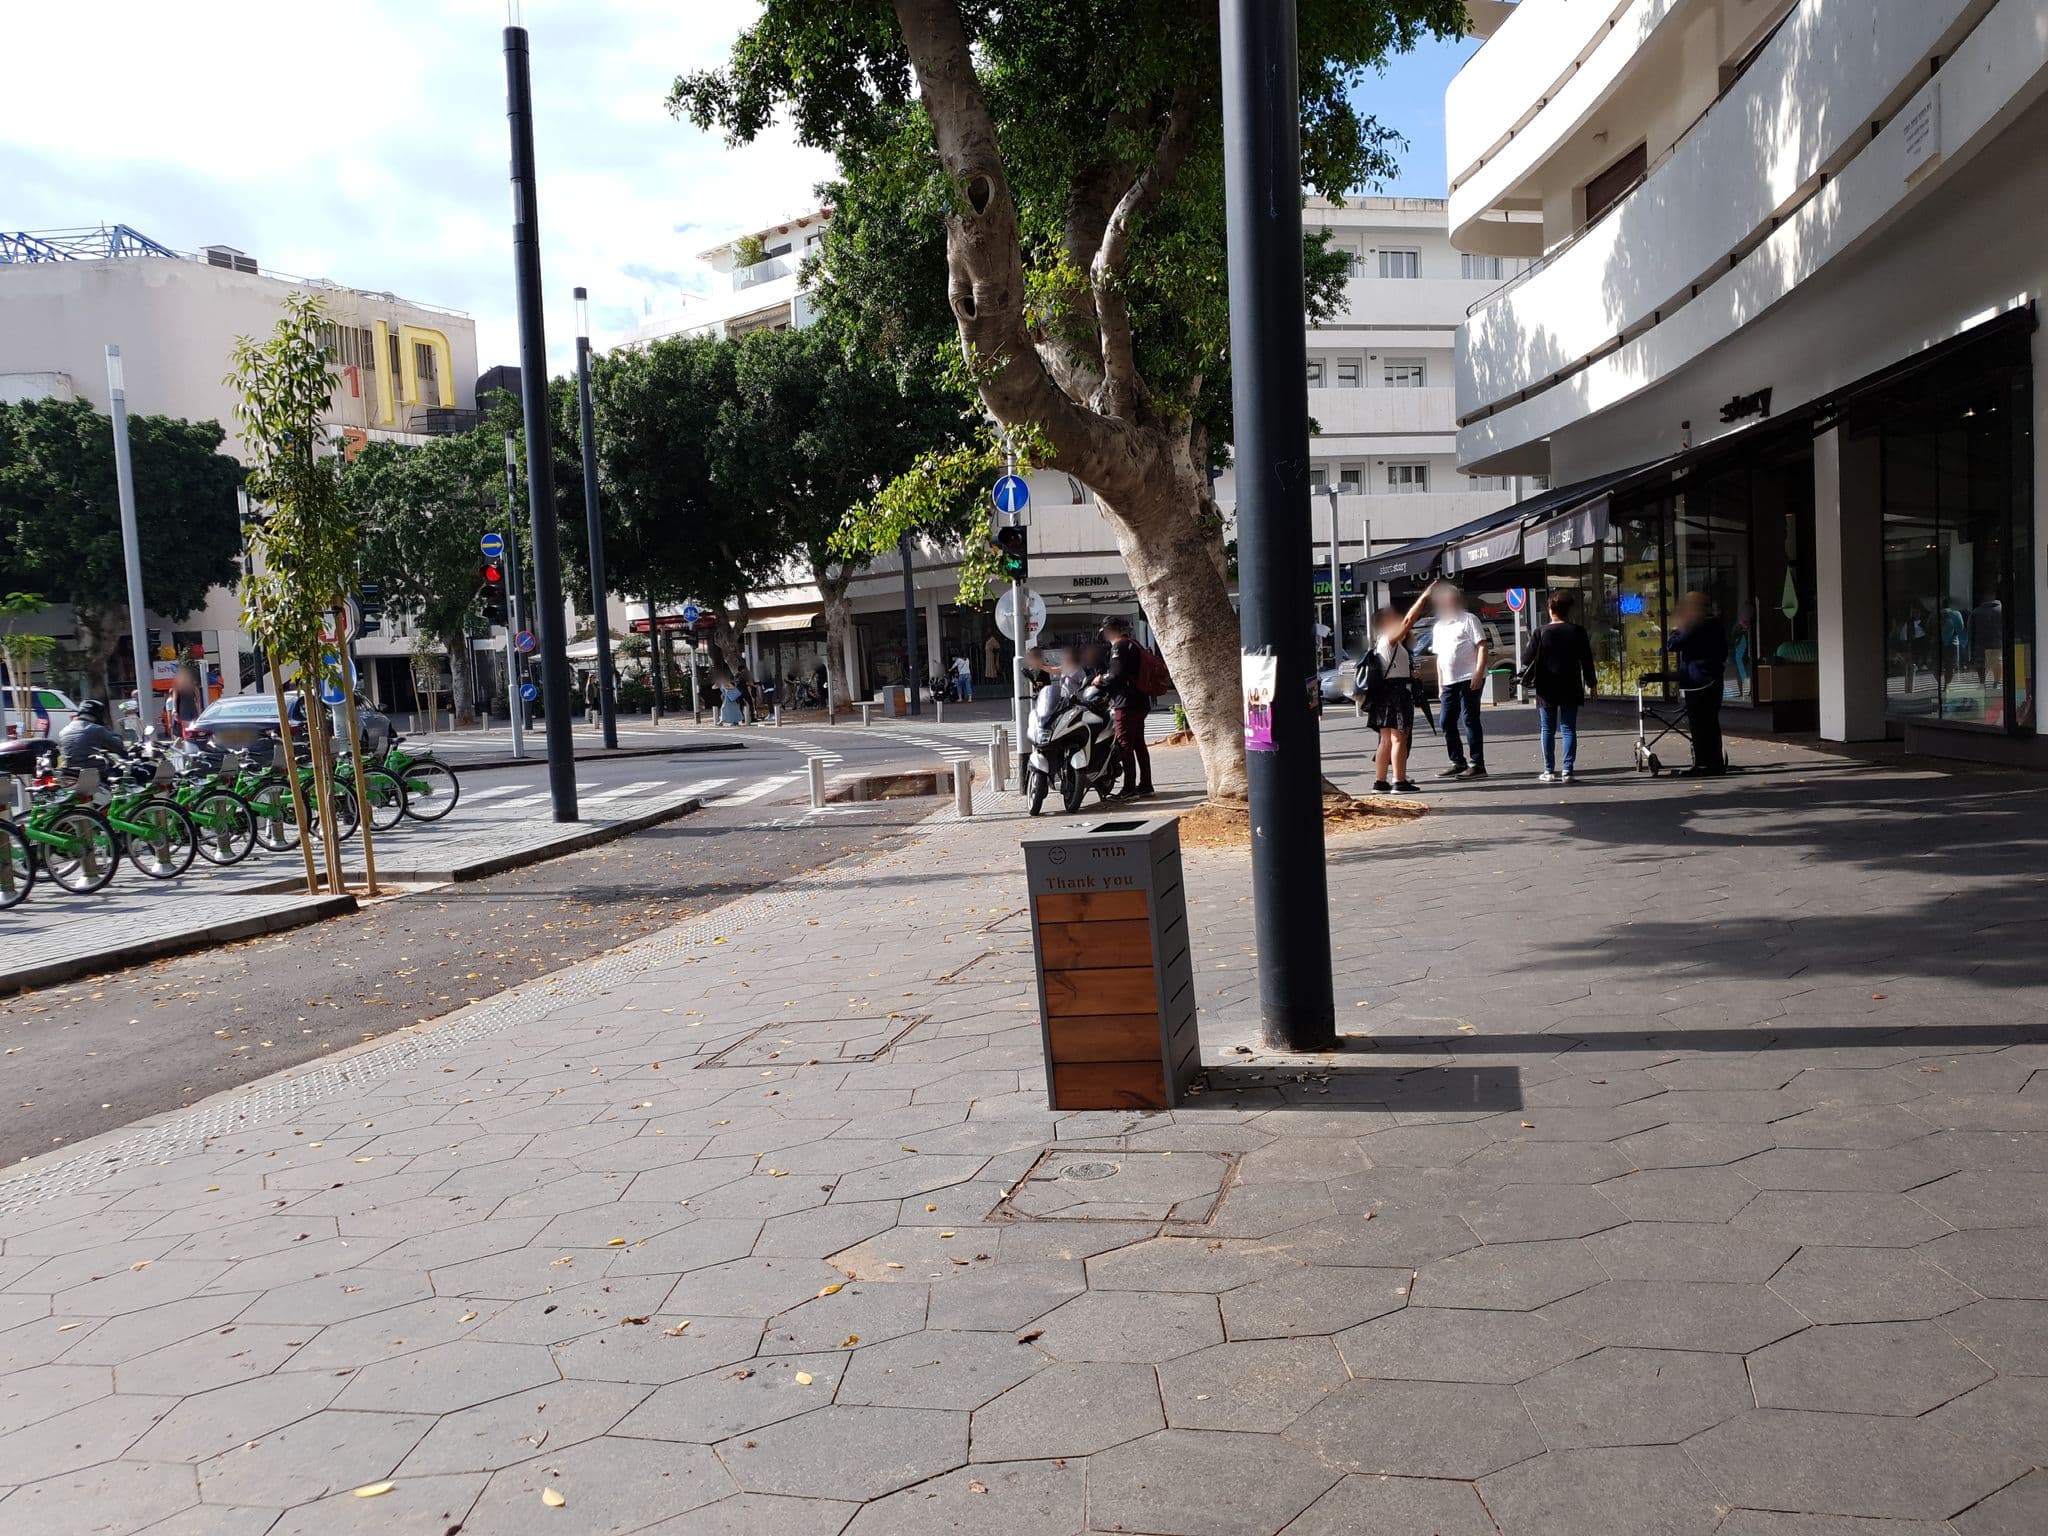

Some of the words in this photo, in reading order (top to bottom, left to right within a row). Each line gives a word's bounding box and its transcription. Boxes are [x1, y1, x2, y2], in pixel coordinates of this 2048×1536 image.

[1073, 577, 1109, 587] BRENDA
[1092, 847, 1126, 858] תודה
[1046, 876, 1095, 889] Thank
[1103, 875, 1133, 889] you
